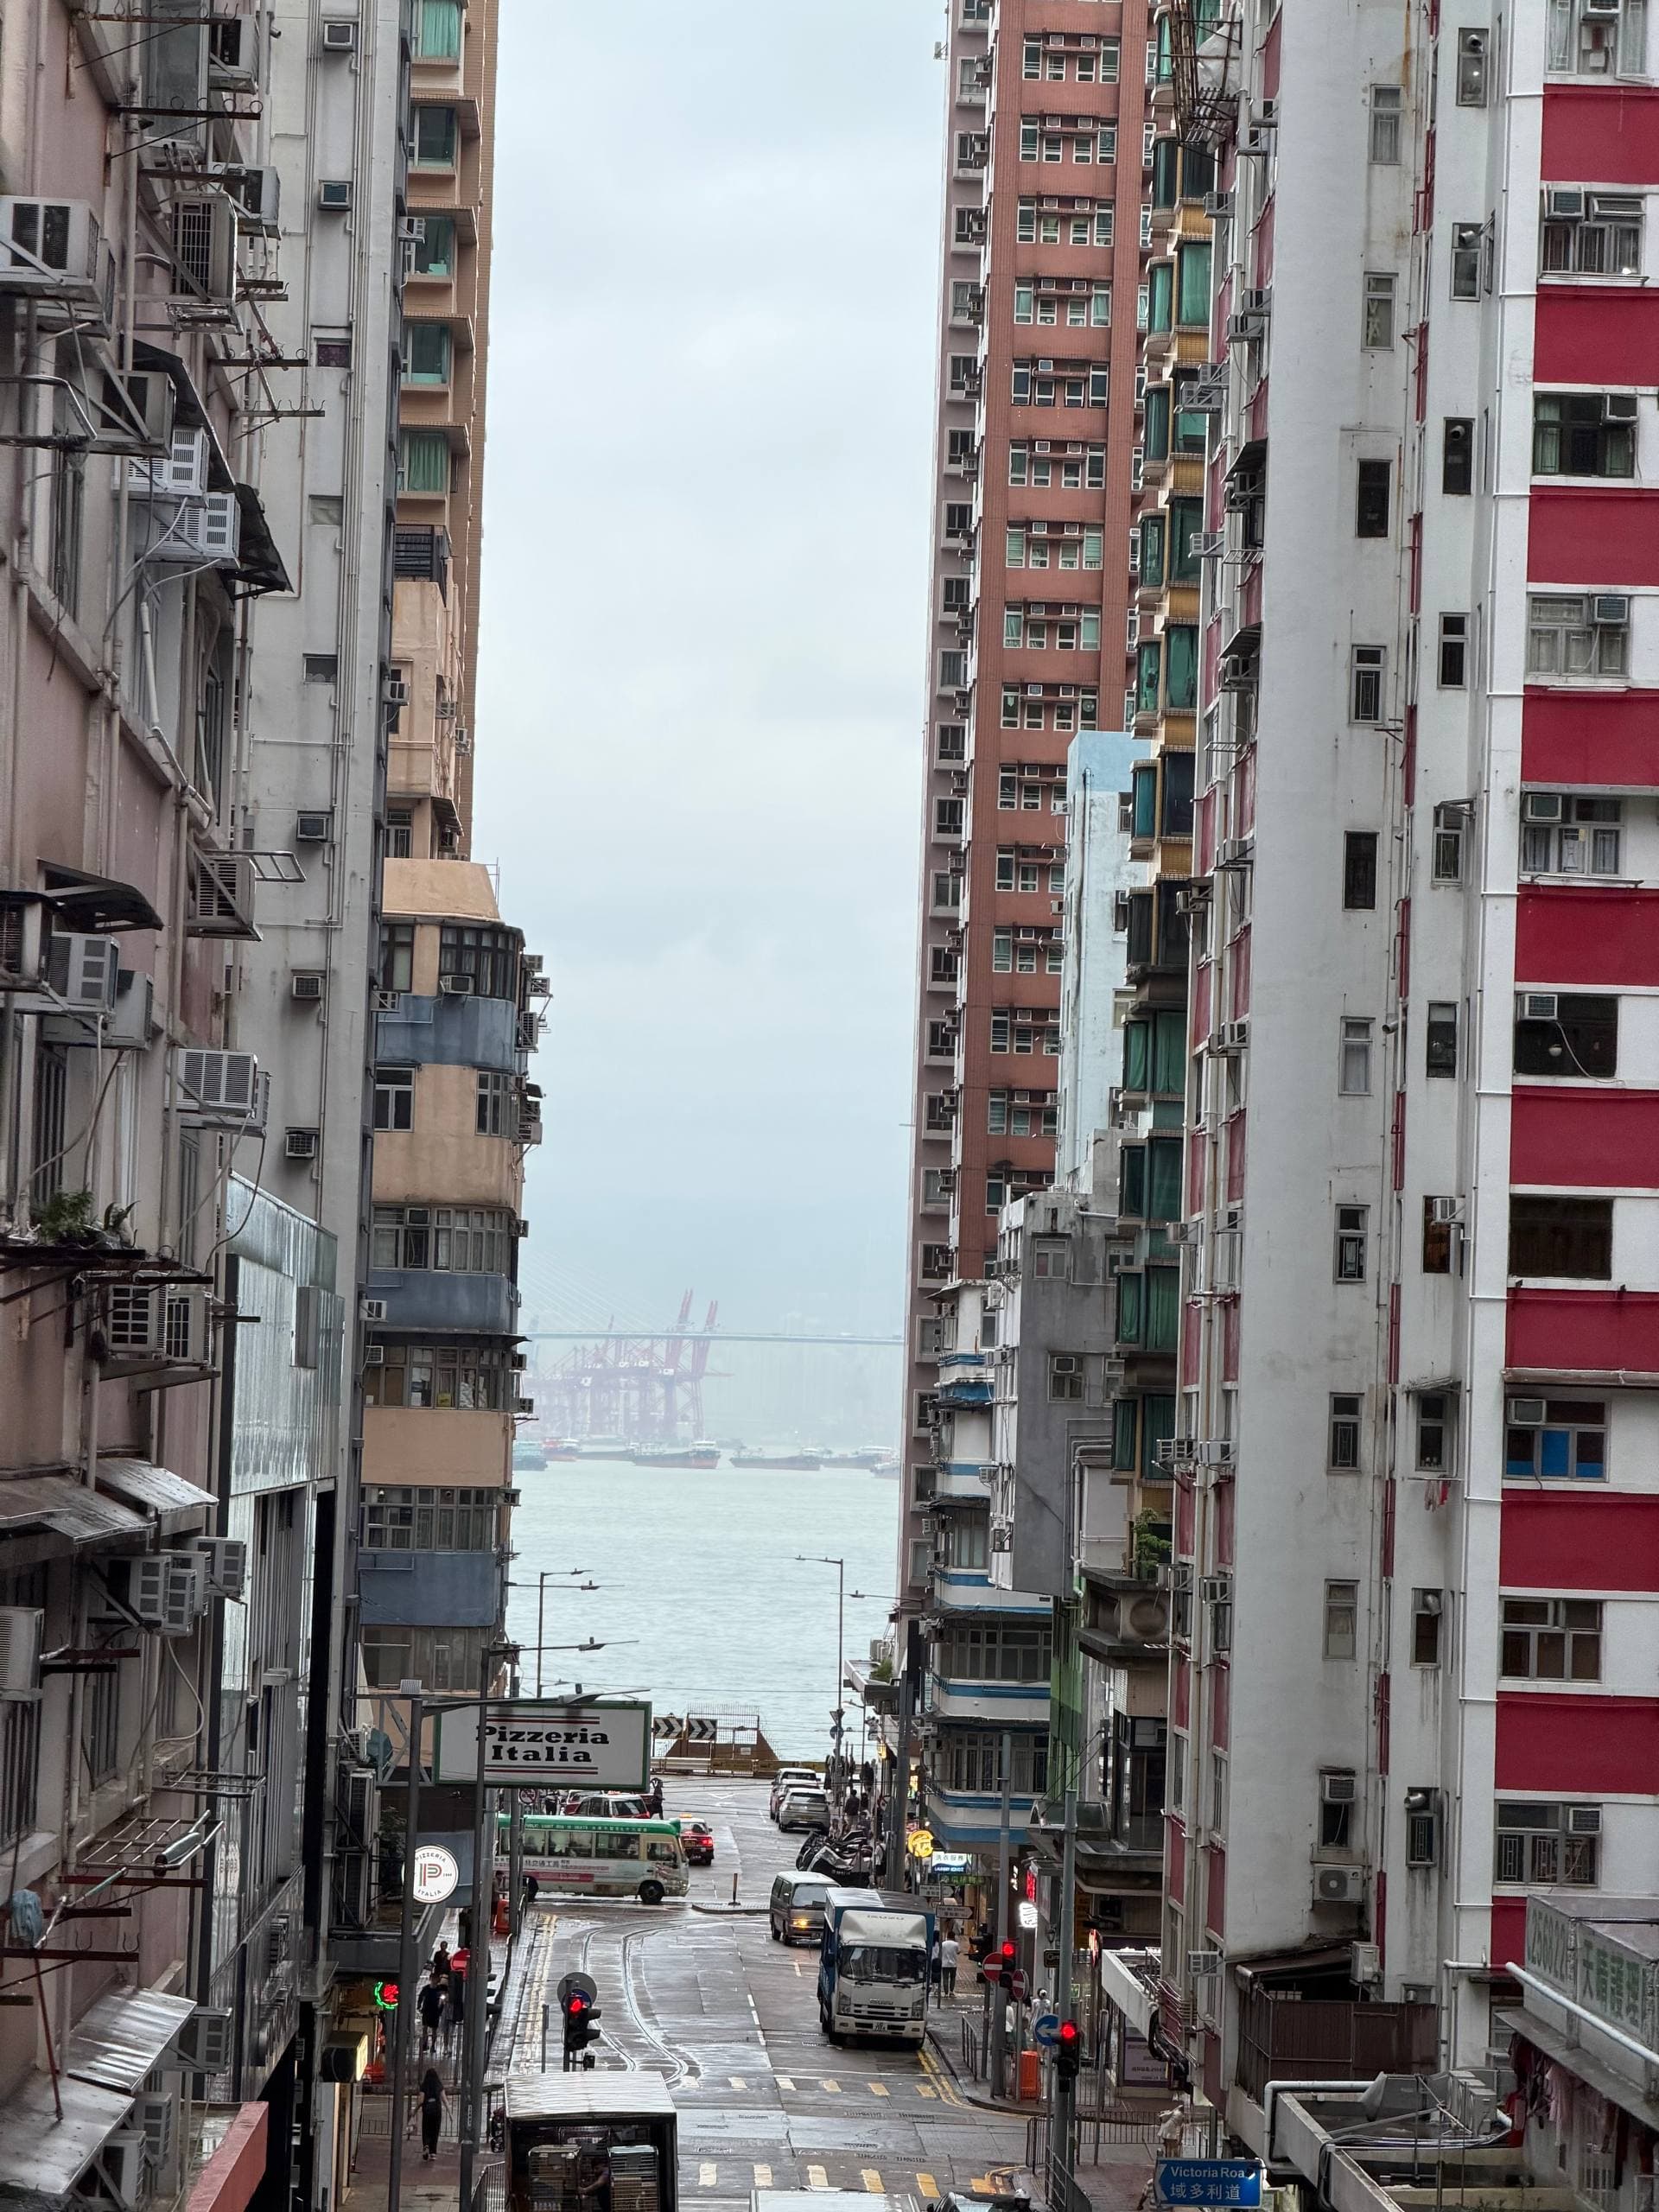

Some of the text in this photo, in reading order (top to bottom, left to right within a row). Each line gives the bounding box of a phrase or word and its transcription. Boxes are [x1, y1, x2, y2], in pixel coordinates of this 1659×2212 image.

[476, 1726, 609, 1745] Pizzeria
[492, 1745, 592, 1763] Italia
[415, 1852, 447, 1863] PIZZERIA
[1170, 2166, 1247, 2178] Victoria Roa
[1169, 2183, 1242, 2201] 域多利道
